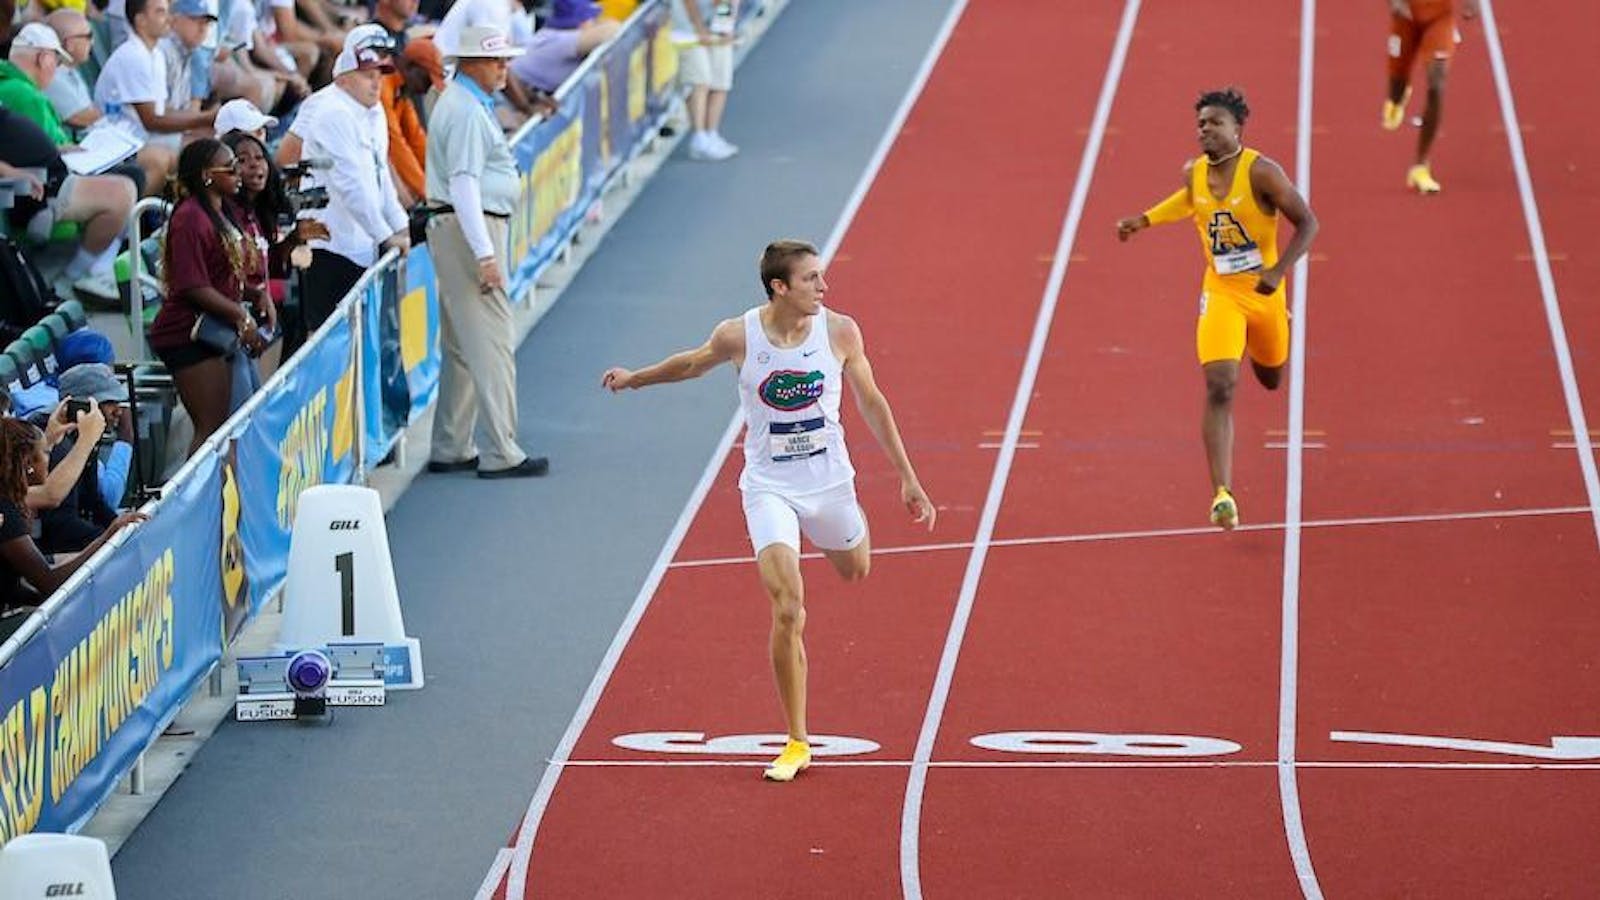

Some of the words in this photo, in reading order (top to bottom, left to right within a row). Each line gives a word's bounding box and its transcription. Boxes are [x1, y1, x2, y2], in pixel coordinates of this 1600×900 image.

[329, 520, 361, 531] GILL
[335, 551, 355, 636] 1
[51, 547, 175, 804] CHAMPIONSHIPS
[327, 694, 383, 704] FUSION
[239, 707, 292, 719] FUSION
[968, 731, 1243, 758] 8
[45, 881, 84, 897] GILL
